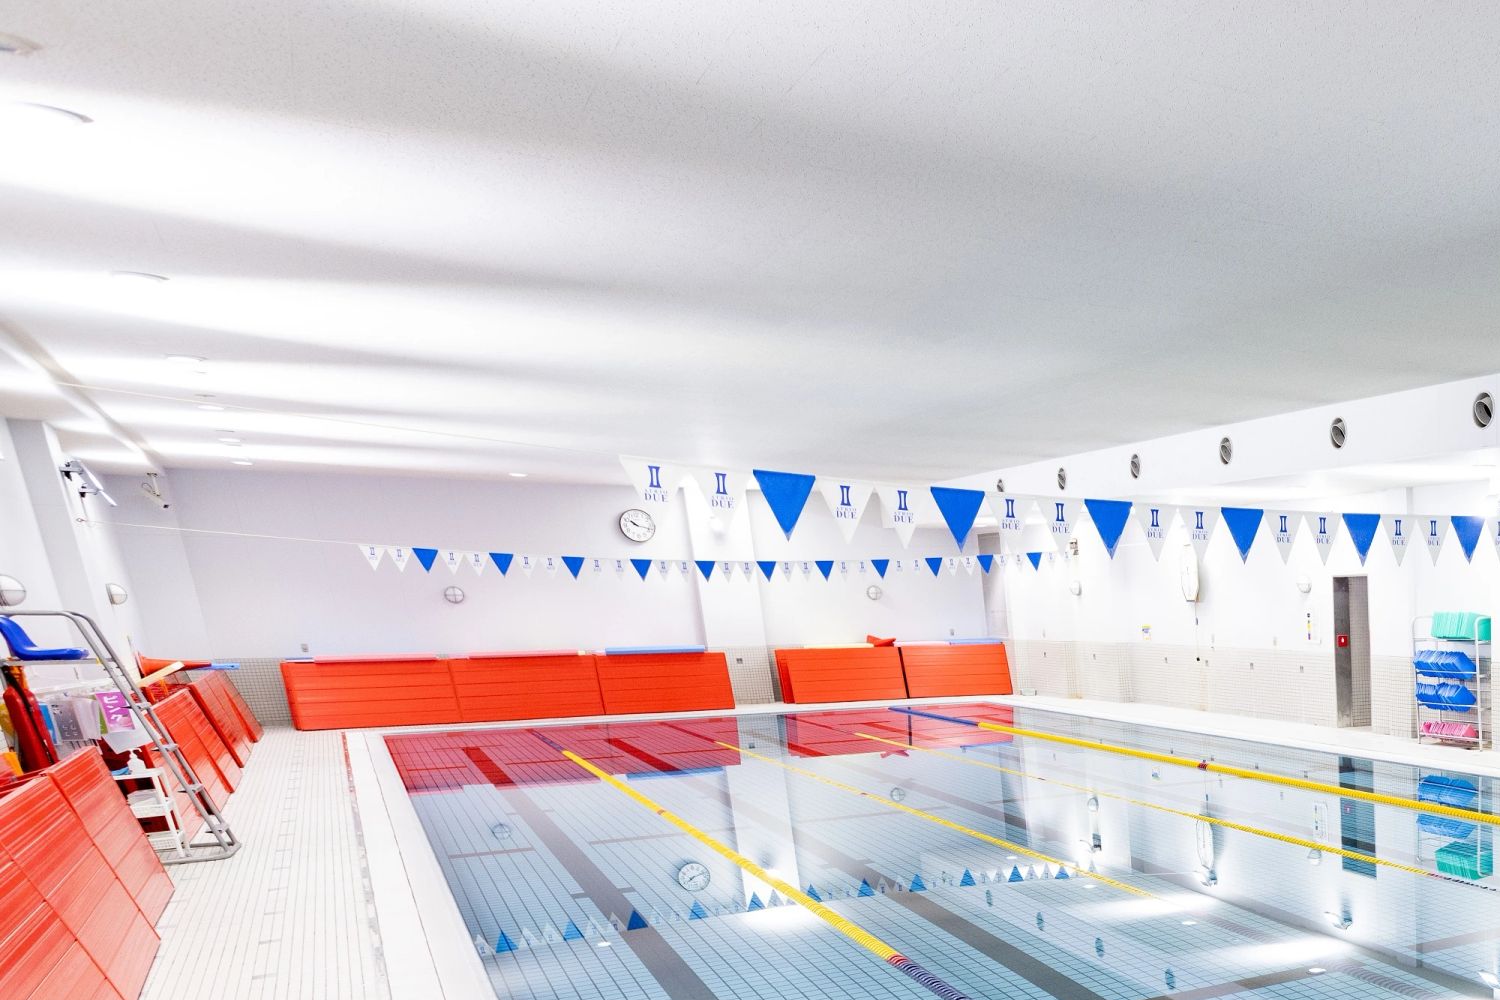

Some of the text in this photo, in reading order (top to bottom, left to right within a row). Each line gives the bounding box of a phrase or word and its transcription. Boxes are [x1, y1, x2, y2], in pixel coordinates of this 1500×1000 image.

[644, 493, 669, 502] DUE
[711, 499, 734, 508] DUE
[836, 511, 857, 519] DUE
[894, 515, 914, 523] DUE
[1002, 523, 1020, 531] DUE
[1052, 526, 1070, 534] DUE
[1147, 531, 1163, 539] DUE
[1192, 533, 1208, 541] DUE
